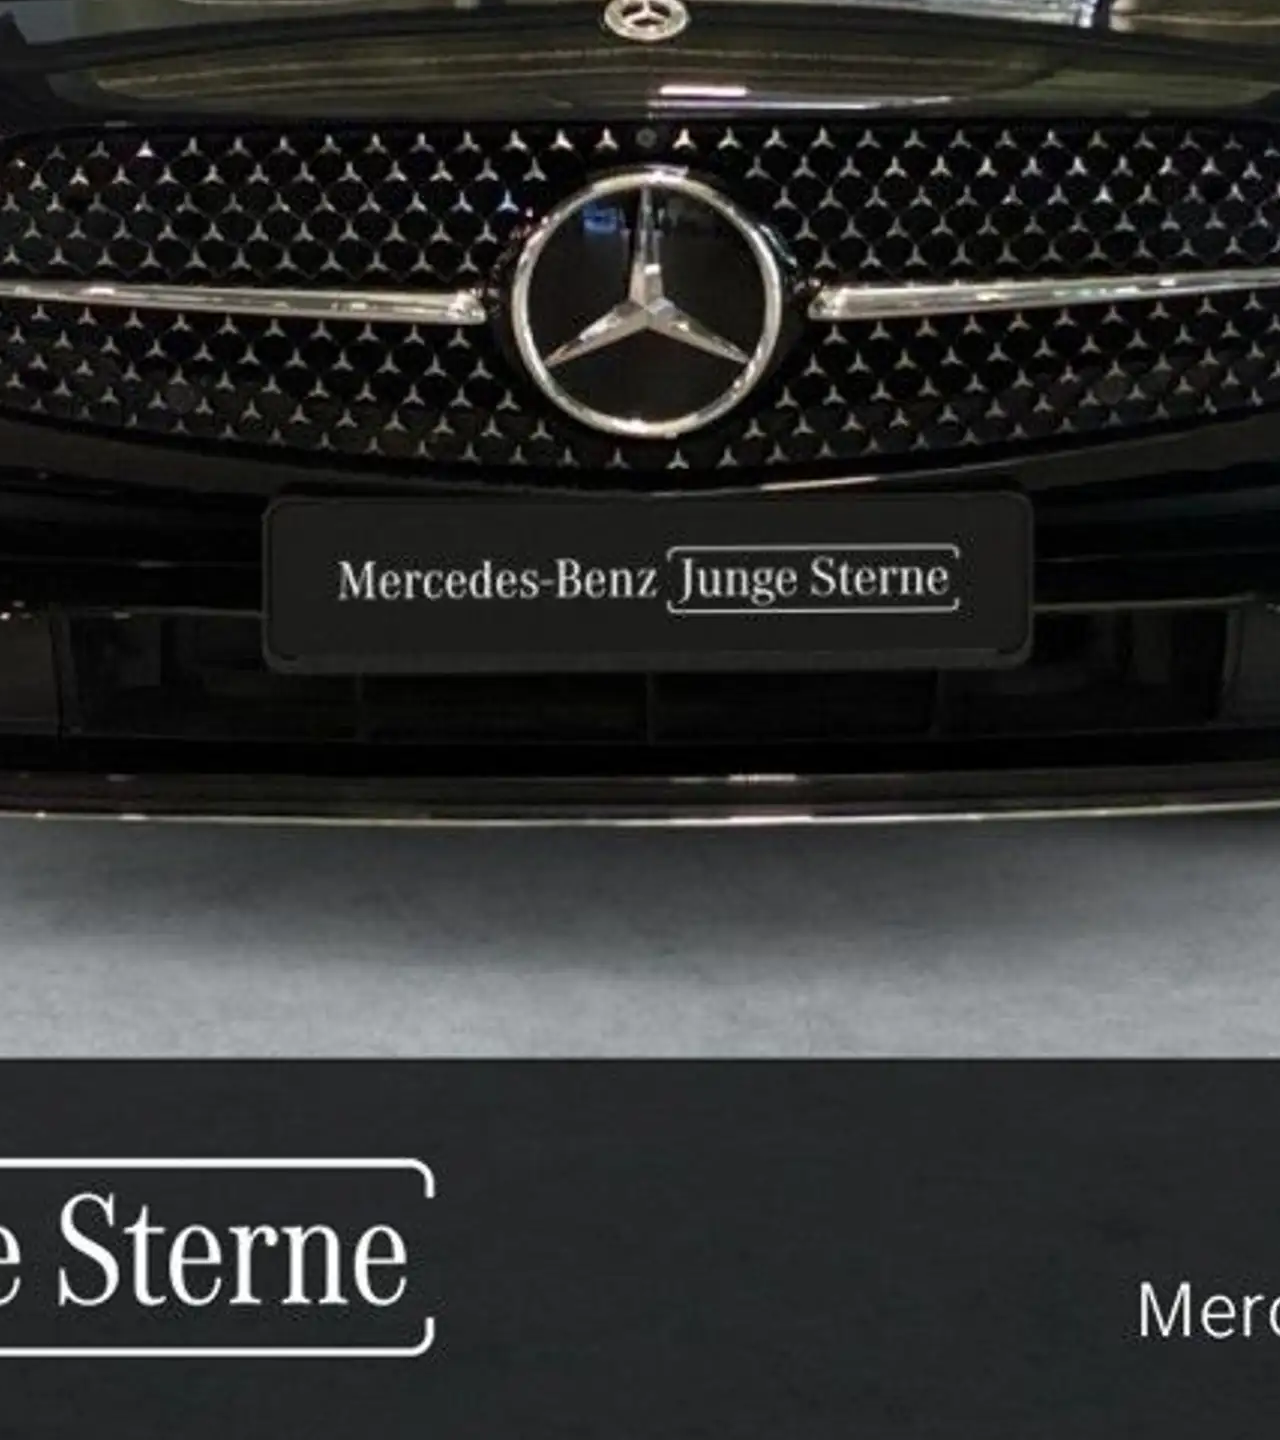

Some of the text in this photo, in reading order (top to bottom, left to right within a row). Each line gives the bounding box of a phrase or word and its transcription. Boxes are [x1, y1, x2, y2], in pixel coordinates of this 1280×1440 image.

[337, 557, 950, 605] Mercedes-Benz Junge Sterne
